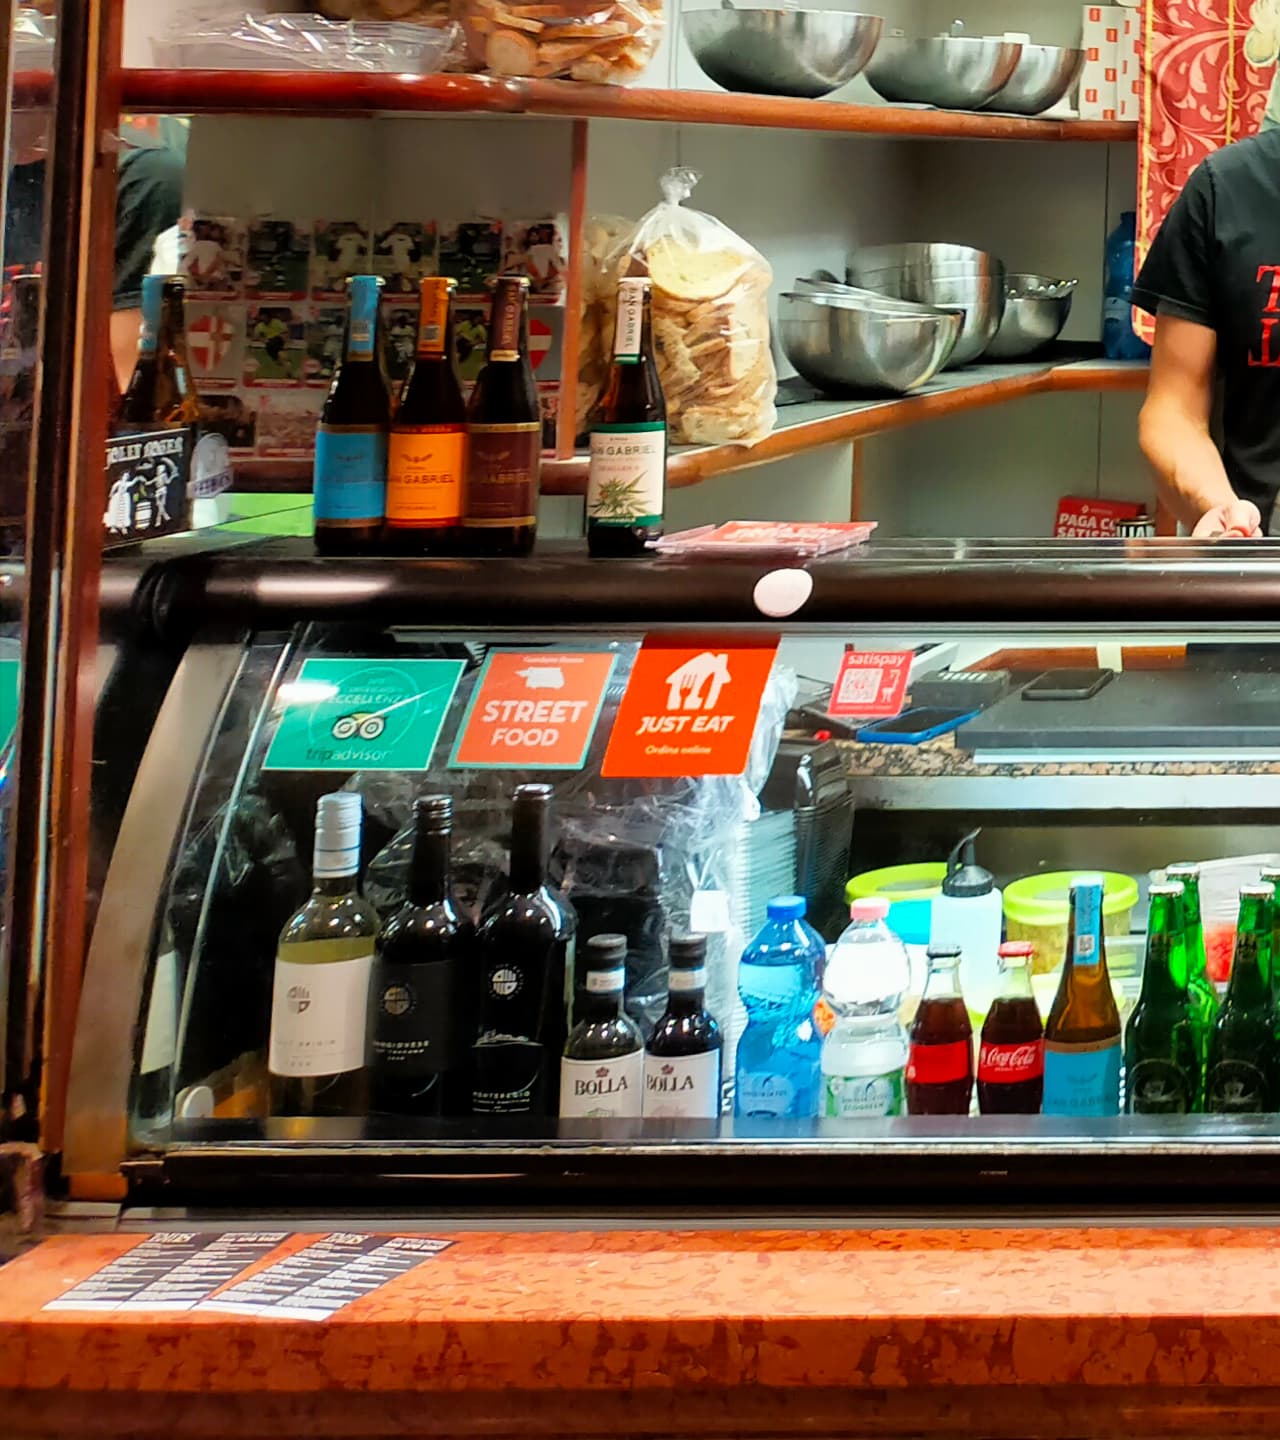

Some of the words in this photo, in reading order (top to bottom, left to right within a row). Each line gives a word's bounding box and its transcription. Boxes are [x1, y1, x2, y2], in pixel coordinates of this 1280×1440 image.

[607, 445, 658, 457] GABRIEL
[403, 473, 455, 485] GABRIEL
[1059, 513, 1098, 528] PAGA
[847, 652, 906, 668] satispay
[482, 700, 589, 723] STREET
[635, 715, 691, 736] JUST
[691, 715, 734, 733] EAT
[491, 728, 559, 747] FOOD
[306, 747, 392, 762] tripadvisor
[574, 1076, 628, 1096] BOLLA
[647, 1074, 694, 1092] BOLLA
